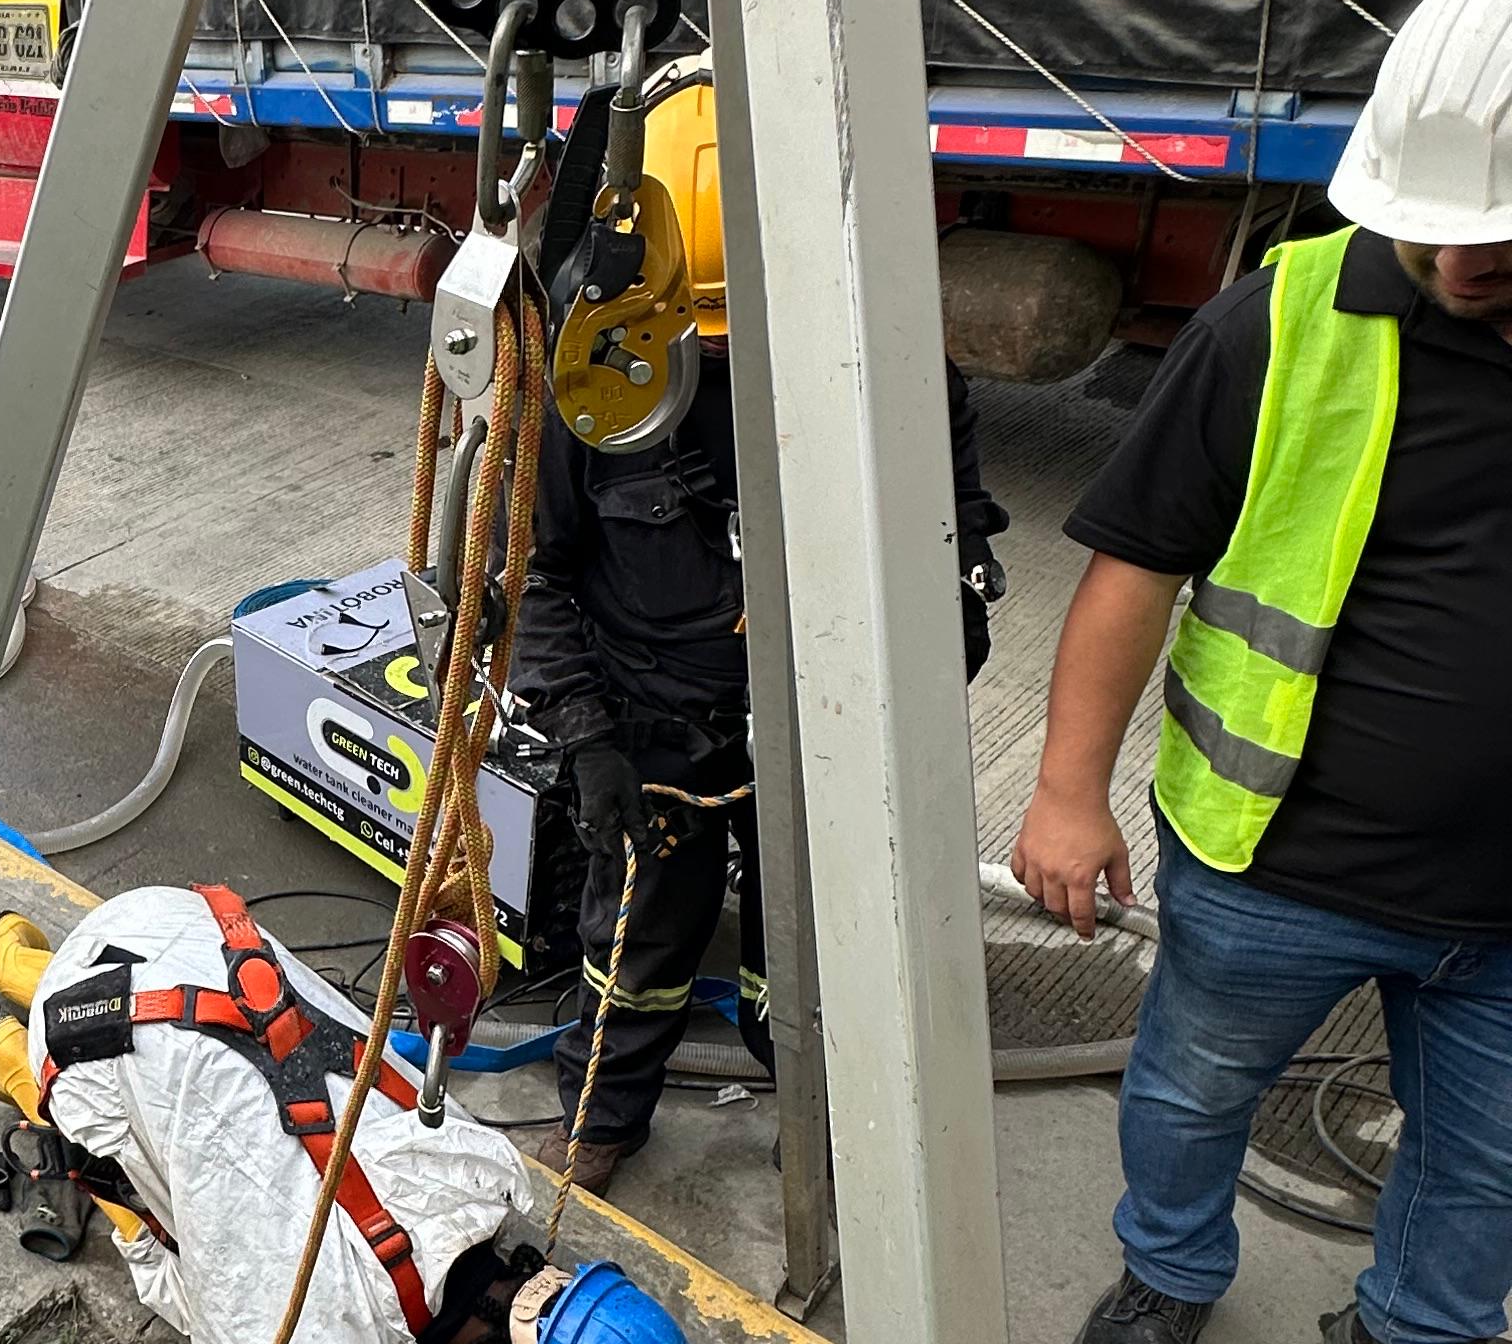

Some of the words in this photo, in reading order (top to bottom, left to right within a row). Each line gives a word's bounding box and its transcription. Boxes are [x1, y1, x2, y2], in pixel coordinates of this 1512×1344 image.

[331, 732, 367, 761] GREEN
[369, 753, 400, 781] TECH
[260, 756, 346, 822] @green.techctg
[292, 753, 324, 779] water
[325, 772, 349, 795] tank
[351, 789, 393, 822] cleaner
[395, 816, 414, 835] ma
[375, 831, 395, 853] Cel
